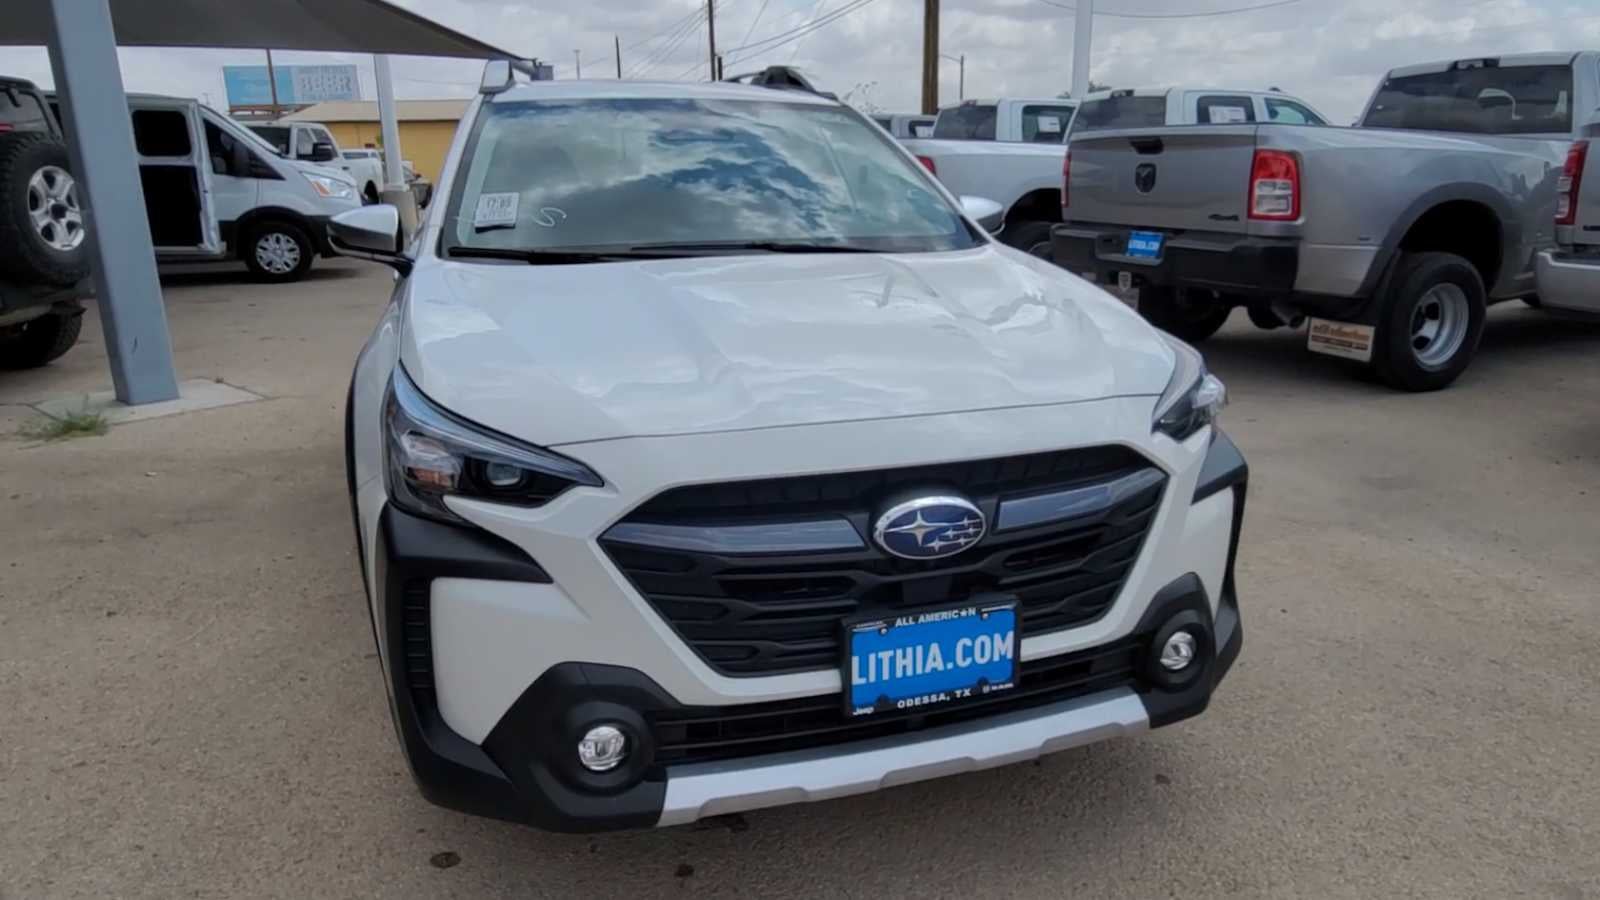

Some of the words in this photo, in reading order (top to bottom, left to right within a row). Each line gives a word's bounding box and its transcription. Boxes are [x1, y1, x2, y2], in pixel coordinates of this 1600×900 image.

[895, 615, 916, 627] ALL
[851, 630, 1014, 685] LITHIA.COM
[897, 690, 951, 709] ODESSA,
[955, 687, 972, 699] TX
